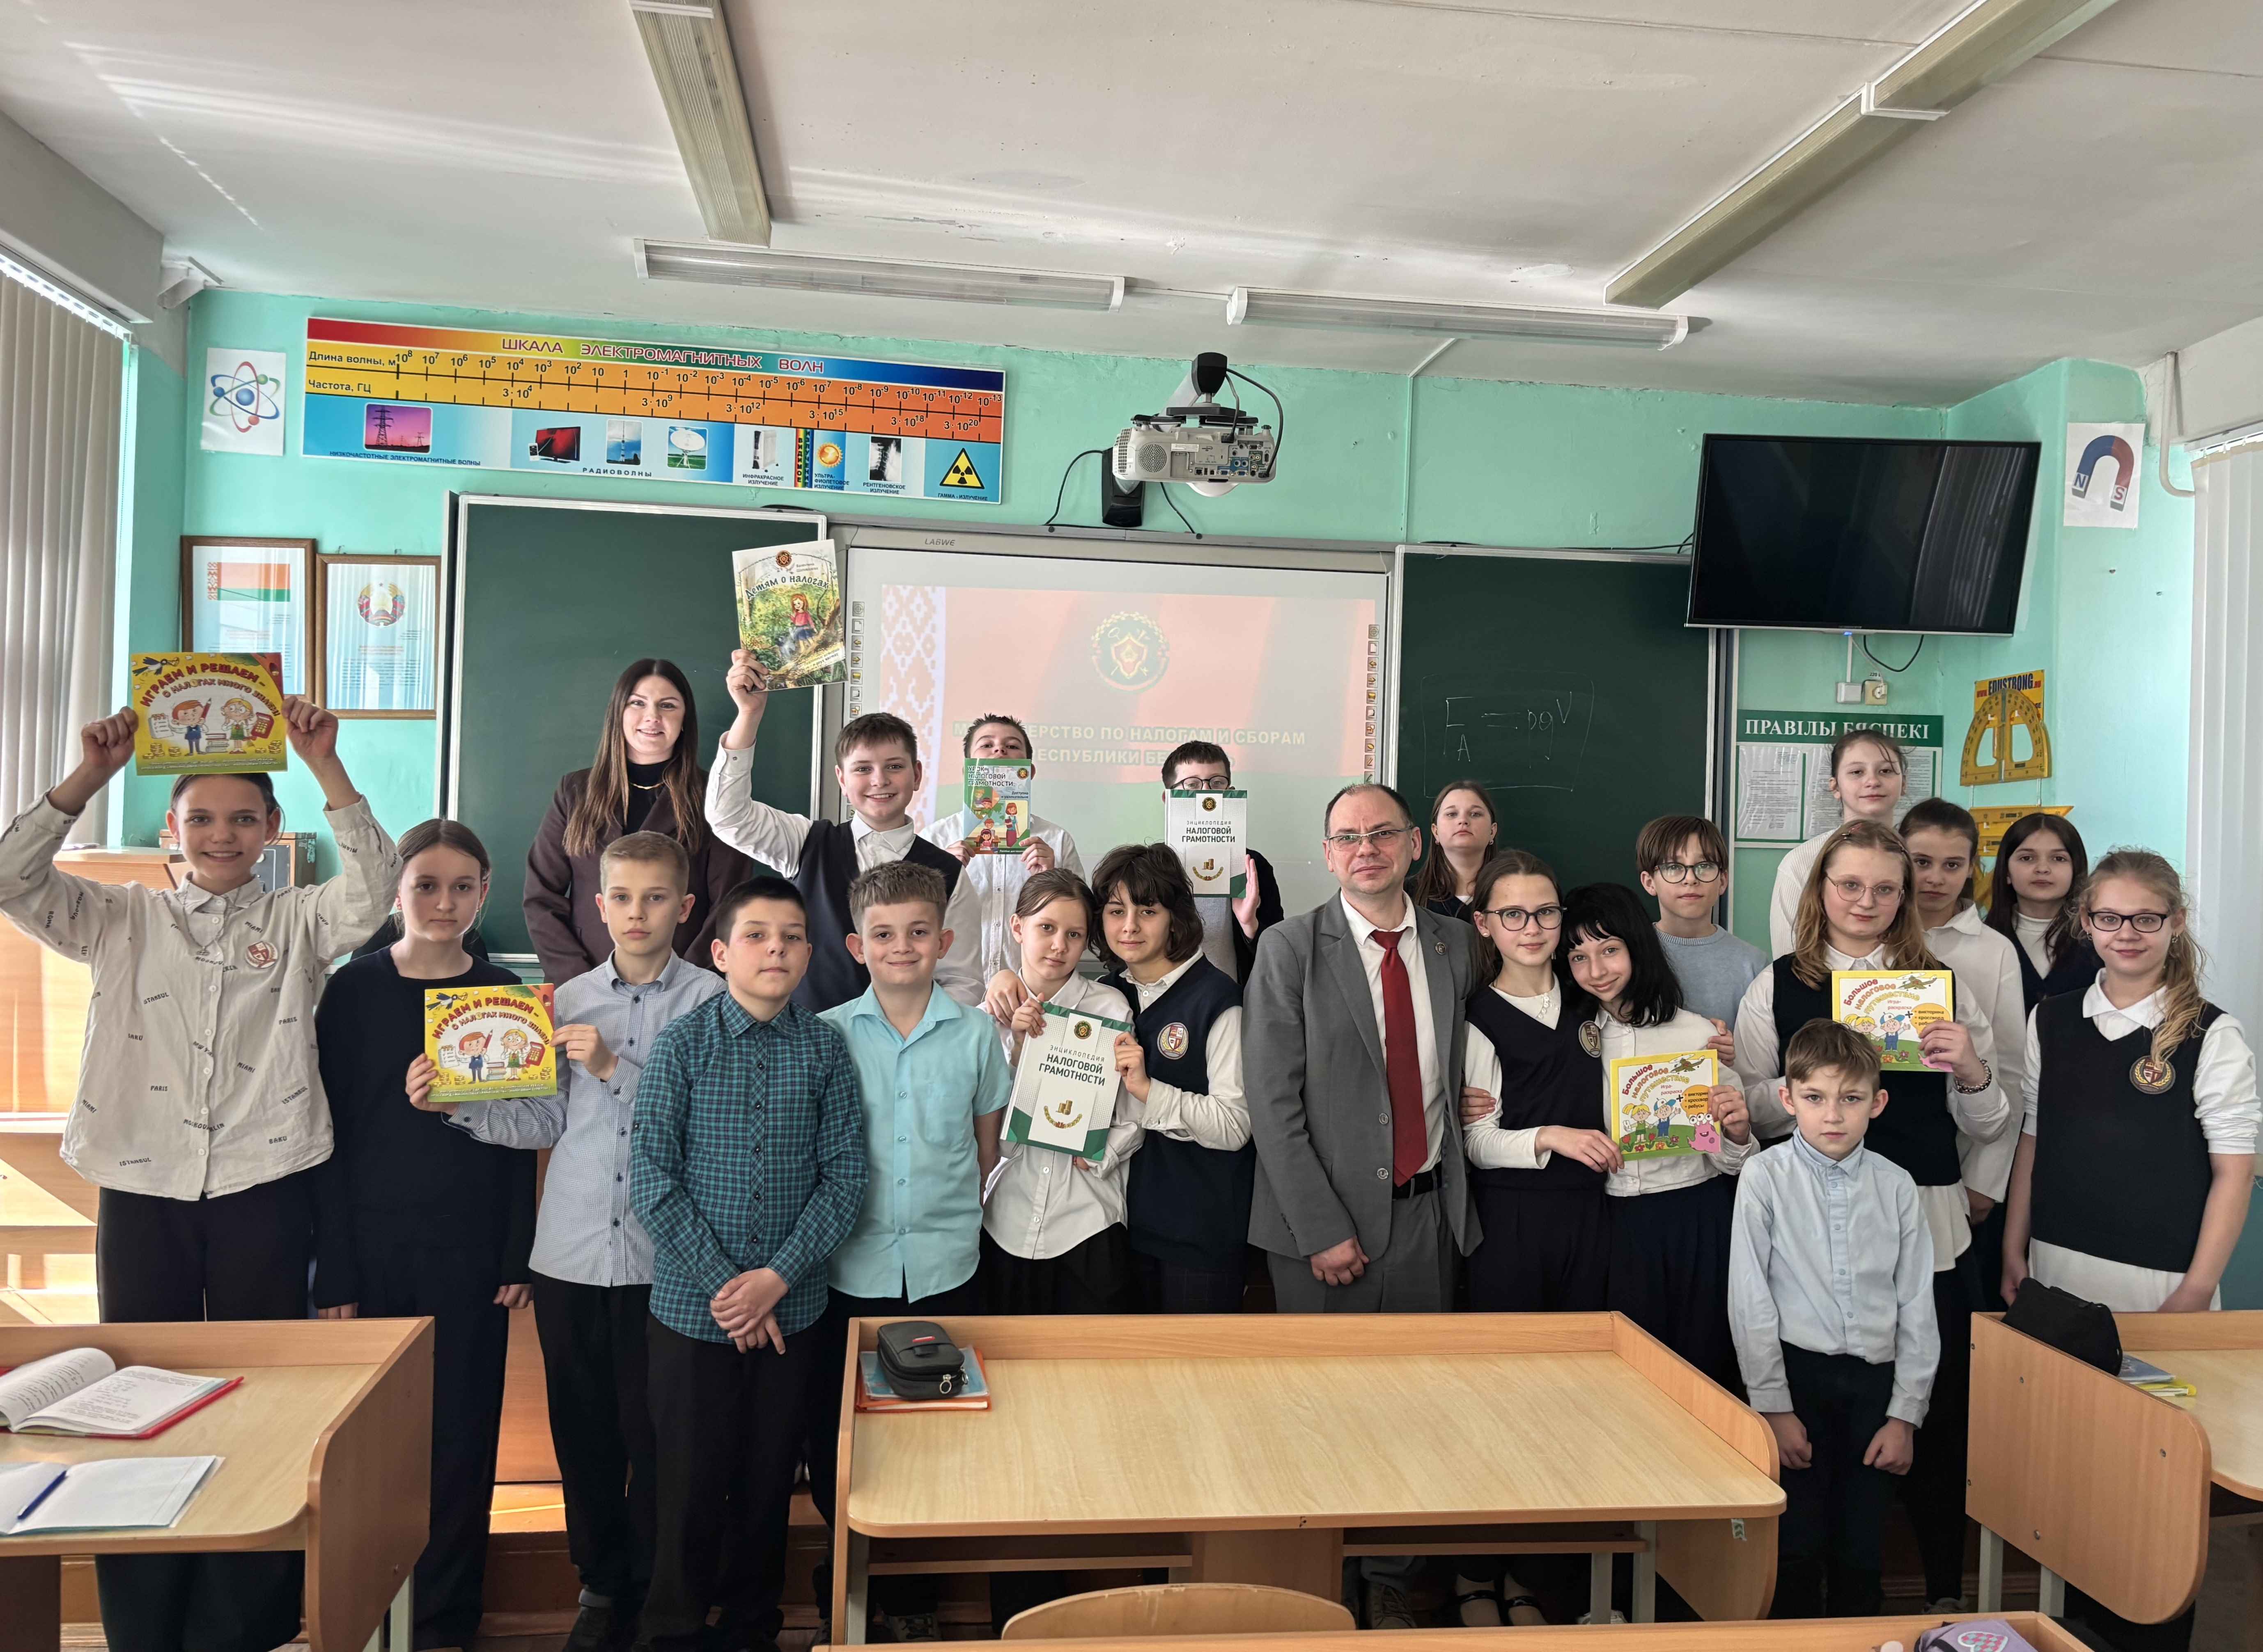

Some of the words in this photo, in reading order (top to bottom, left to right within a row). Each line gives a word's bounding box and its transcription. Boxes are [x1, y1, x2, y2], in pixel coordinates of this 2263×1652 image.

[309, 351, 343, 362] Длина
[347, 356, 385, 366] волны,
[502, 338, 563, 354] ШКАЛА
[580, 344, 762, 369] ЭЛЕКТРОМАГНИТНЫХ
[778, 359, 824, 373] ВОЛН
[592, 367, 604, 376] 10
[623, 369, 628, 378] 1
[308, 379, 353, 392] Частота,
[357, 383, 371, 393] ГЦ
[330, 451, 388, 460] НИЗКОЧАСТОТНЫЕ
[390, 455, 457, 464] ЭЛЕКТРОМАГНИТНЫЕ
[582, 467, 652, 477] РАДИОВОЛНЫ
[2074, 473, 2086, 488] N
[2114, 486, 2125, 500] S
[925, 538, 955, 546] LABWE
[745, 576, 779, 600] Детям
[790, 576, 829, 589] налогах
[140, 668, 184, 707] ИГРАЕМ
[187, 664, 197, 675] И
[200, 663, 259, 683] РЕШАЕМ
[170, 679, 216, 694] НАЛОГАХ
[218, 679, 252, 693] МНОГО
[954, 723, 1095, 739] МЕРСТВО
[1101, 727, 1124, 739] ПО
[1130, 727, 1212, 742] НАЛОГАМ
[1218, 730, 1229, 742] И
[1235, 730, 1305, 745] СБОРАМ
[1744, 719, 1837, 737] ПРАВІЛЫ
[1038, 749, 1140, 764] ЕСПУБЛИКИ
[1186, 826, 1231, 834] НАЛОГОВОЙ
[245, 921, 263, 933] MIAMI
[143, 992, 170, 1005] STANBUL
[1843, 979, 1878, 1006] Большое
[1854, 983, 1896, 1010] налоговое
[279, 1016, 298, 1025] PARIS
[432, 1003, 471, 1039] ИГРАЕМ
[473, 999, 482, 1009] И
[485, 997, 534, 1014] РЕШАЕМ
[459, 1011, 497, 1026] НАЛОГАХ
[499, 1011, 528, 1025] МНОГО
[1050, 1045, 1105, 1062] ЭНЦИКЛОПЕДИЯ
[236, 1062, 256, 1074] MIAMI
[1047, 1053, 1104, 1074] НАЛОГОВОЙ
[1038, 1063, 1106, 1086] ГРАМОТНОСТИ
[1622, 1064, 1653, 1095] Большое
[1632, 1067, 1669, 1099] налоговое
[281, 1085, 308, 1104] ISTANBUL
[82, 1099, 96, 1114] MIAMI
[269, 1136, 287, 1144] BAKU
[119, 1157, 151, 1167] ISTANBUL
